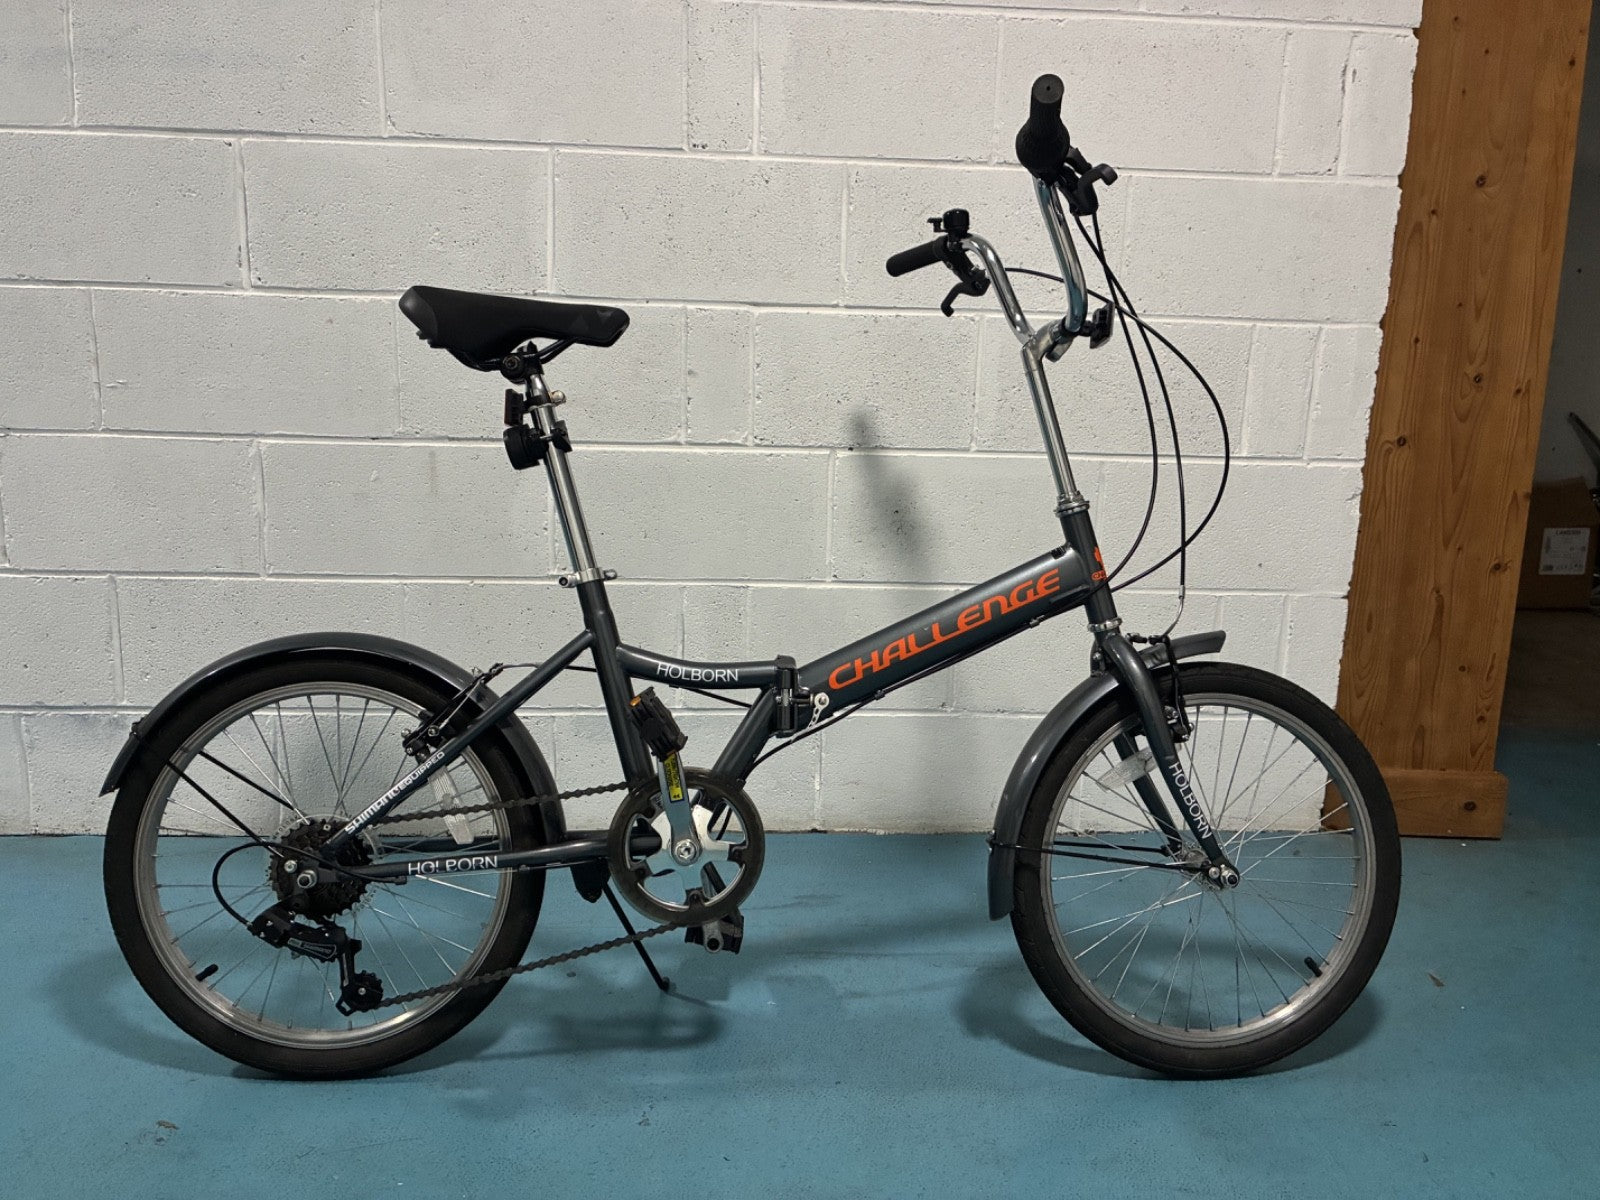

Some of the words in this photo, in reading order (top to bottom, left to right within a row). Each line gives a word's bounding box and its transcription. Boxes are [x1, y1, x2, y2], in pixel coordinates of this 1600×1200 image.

[828, 568, 1061, 690] CHALLENGE
[656, 663, 739, 683] HOLBORN
[399, 751, 445, 791] EQUIPPED
[1168, 761, 1213, 839] HOLBORN
